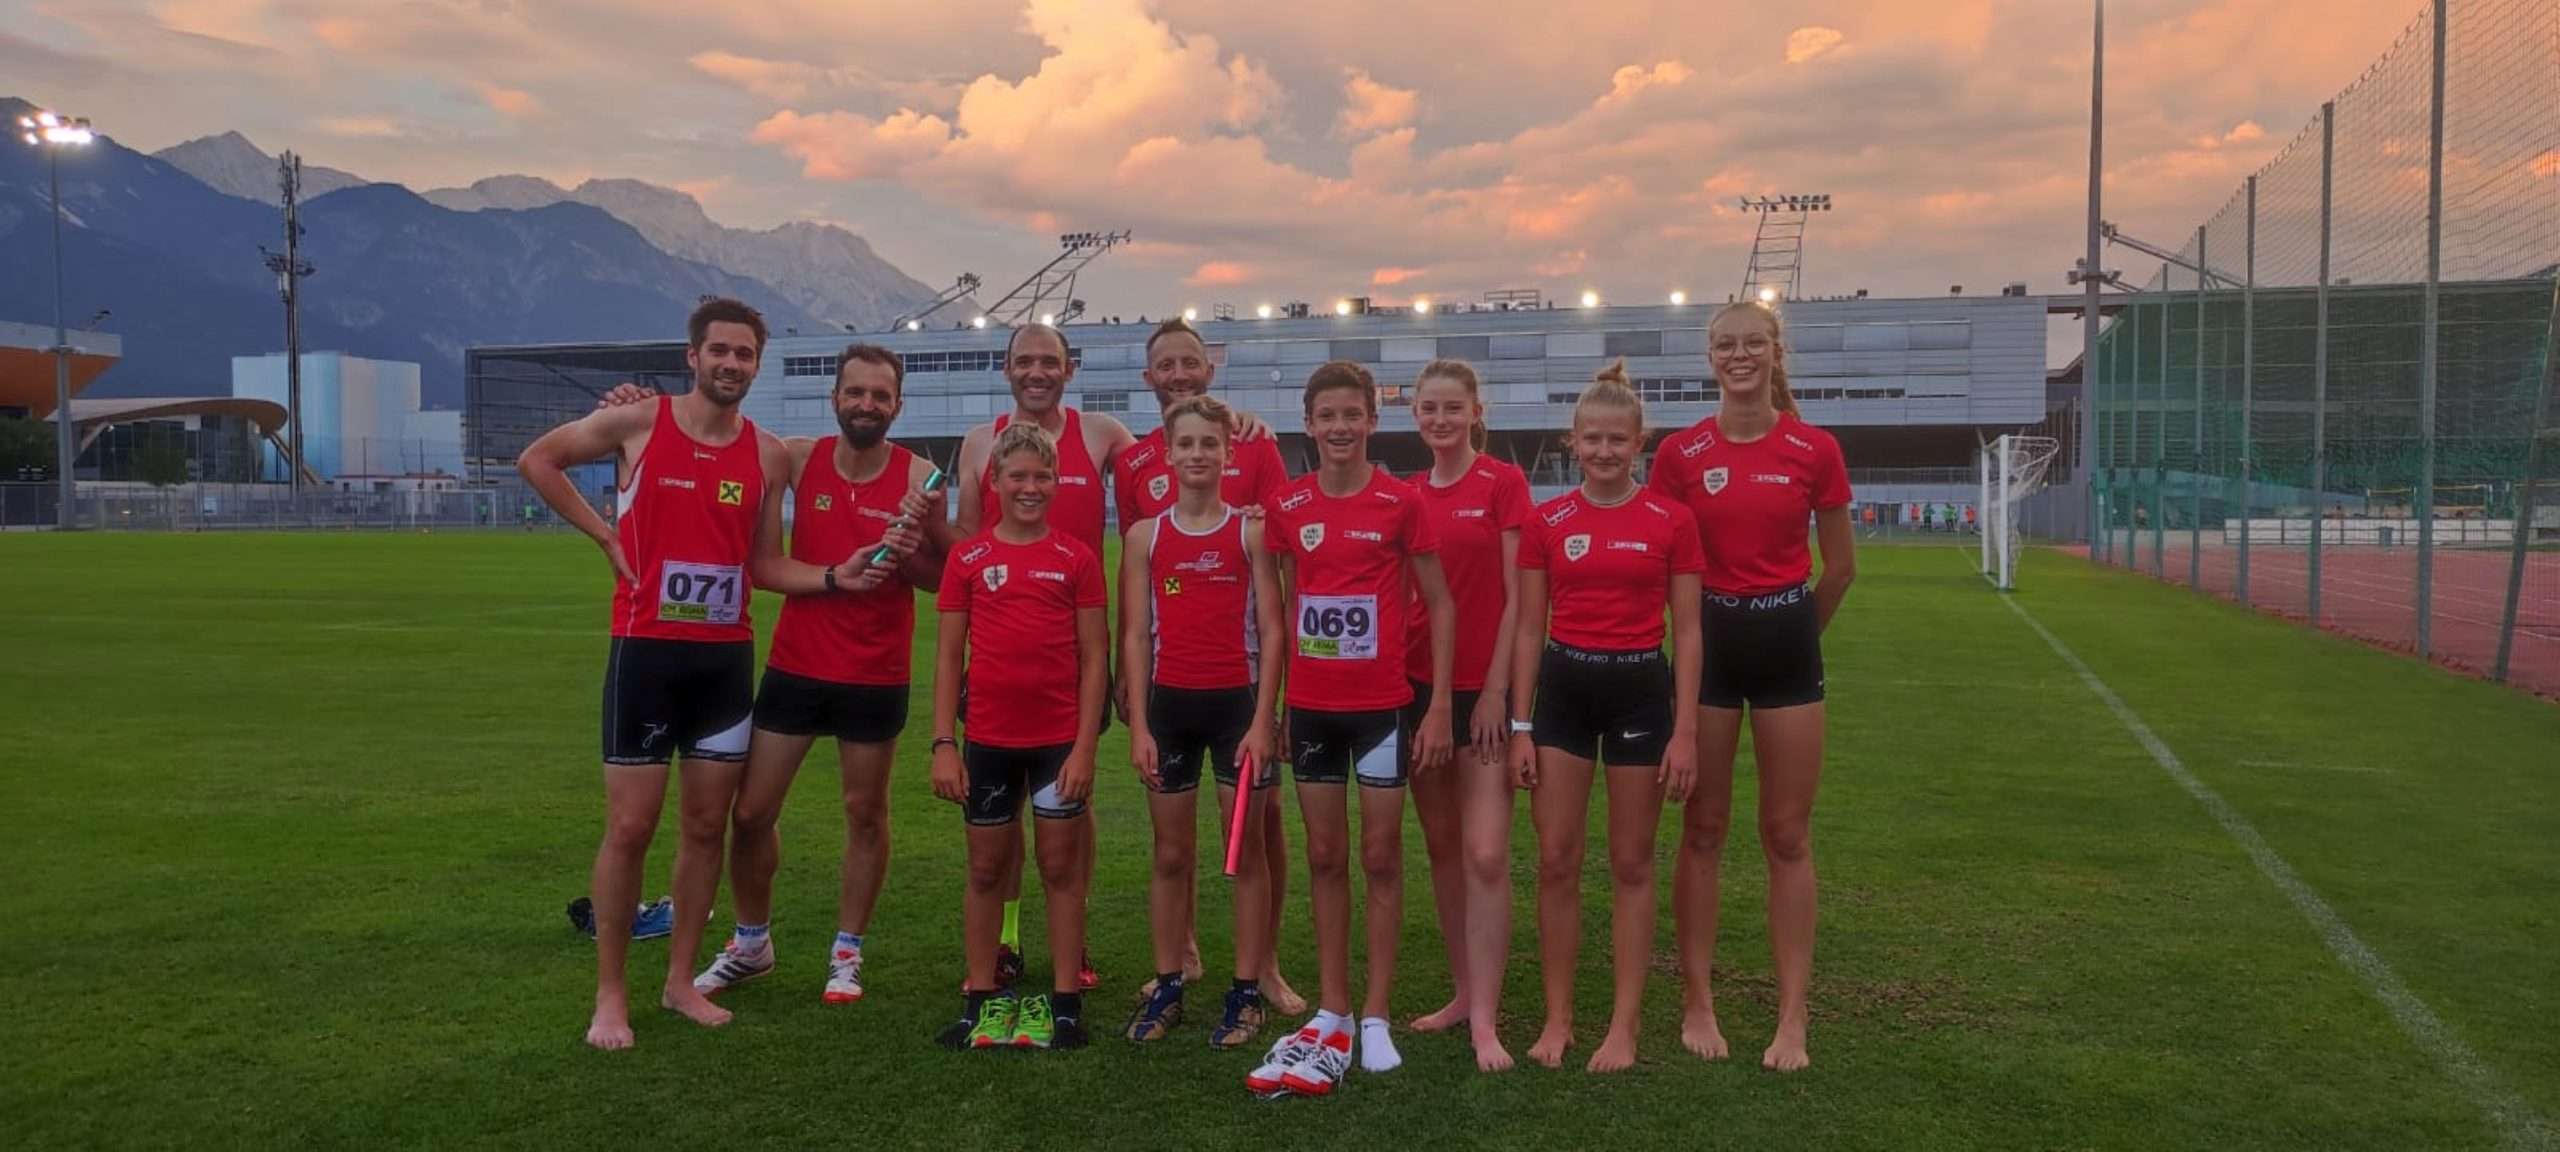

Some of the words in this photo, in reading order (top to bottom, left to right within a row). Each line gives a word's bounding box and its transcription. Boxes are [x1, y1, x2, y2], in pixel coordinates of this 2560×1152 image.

[667, 573, 735, 604] 071
[1750, 588, 1801, 610] NIKE
[1303, 606, 1370, 638] 069
[1616, 653, 1641, 663] NIKE
